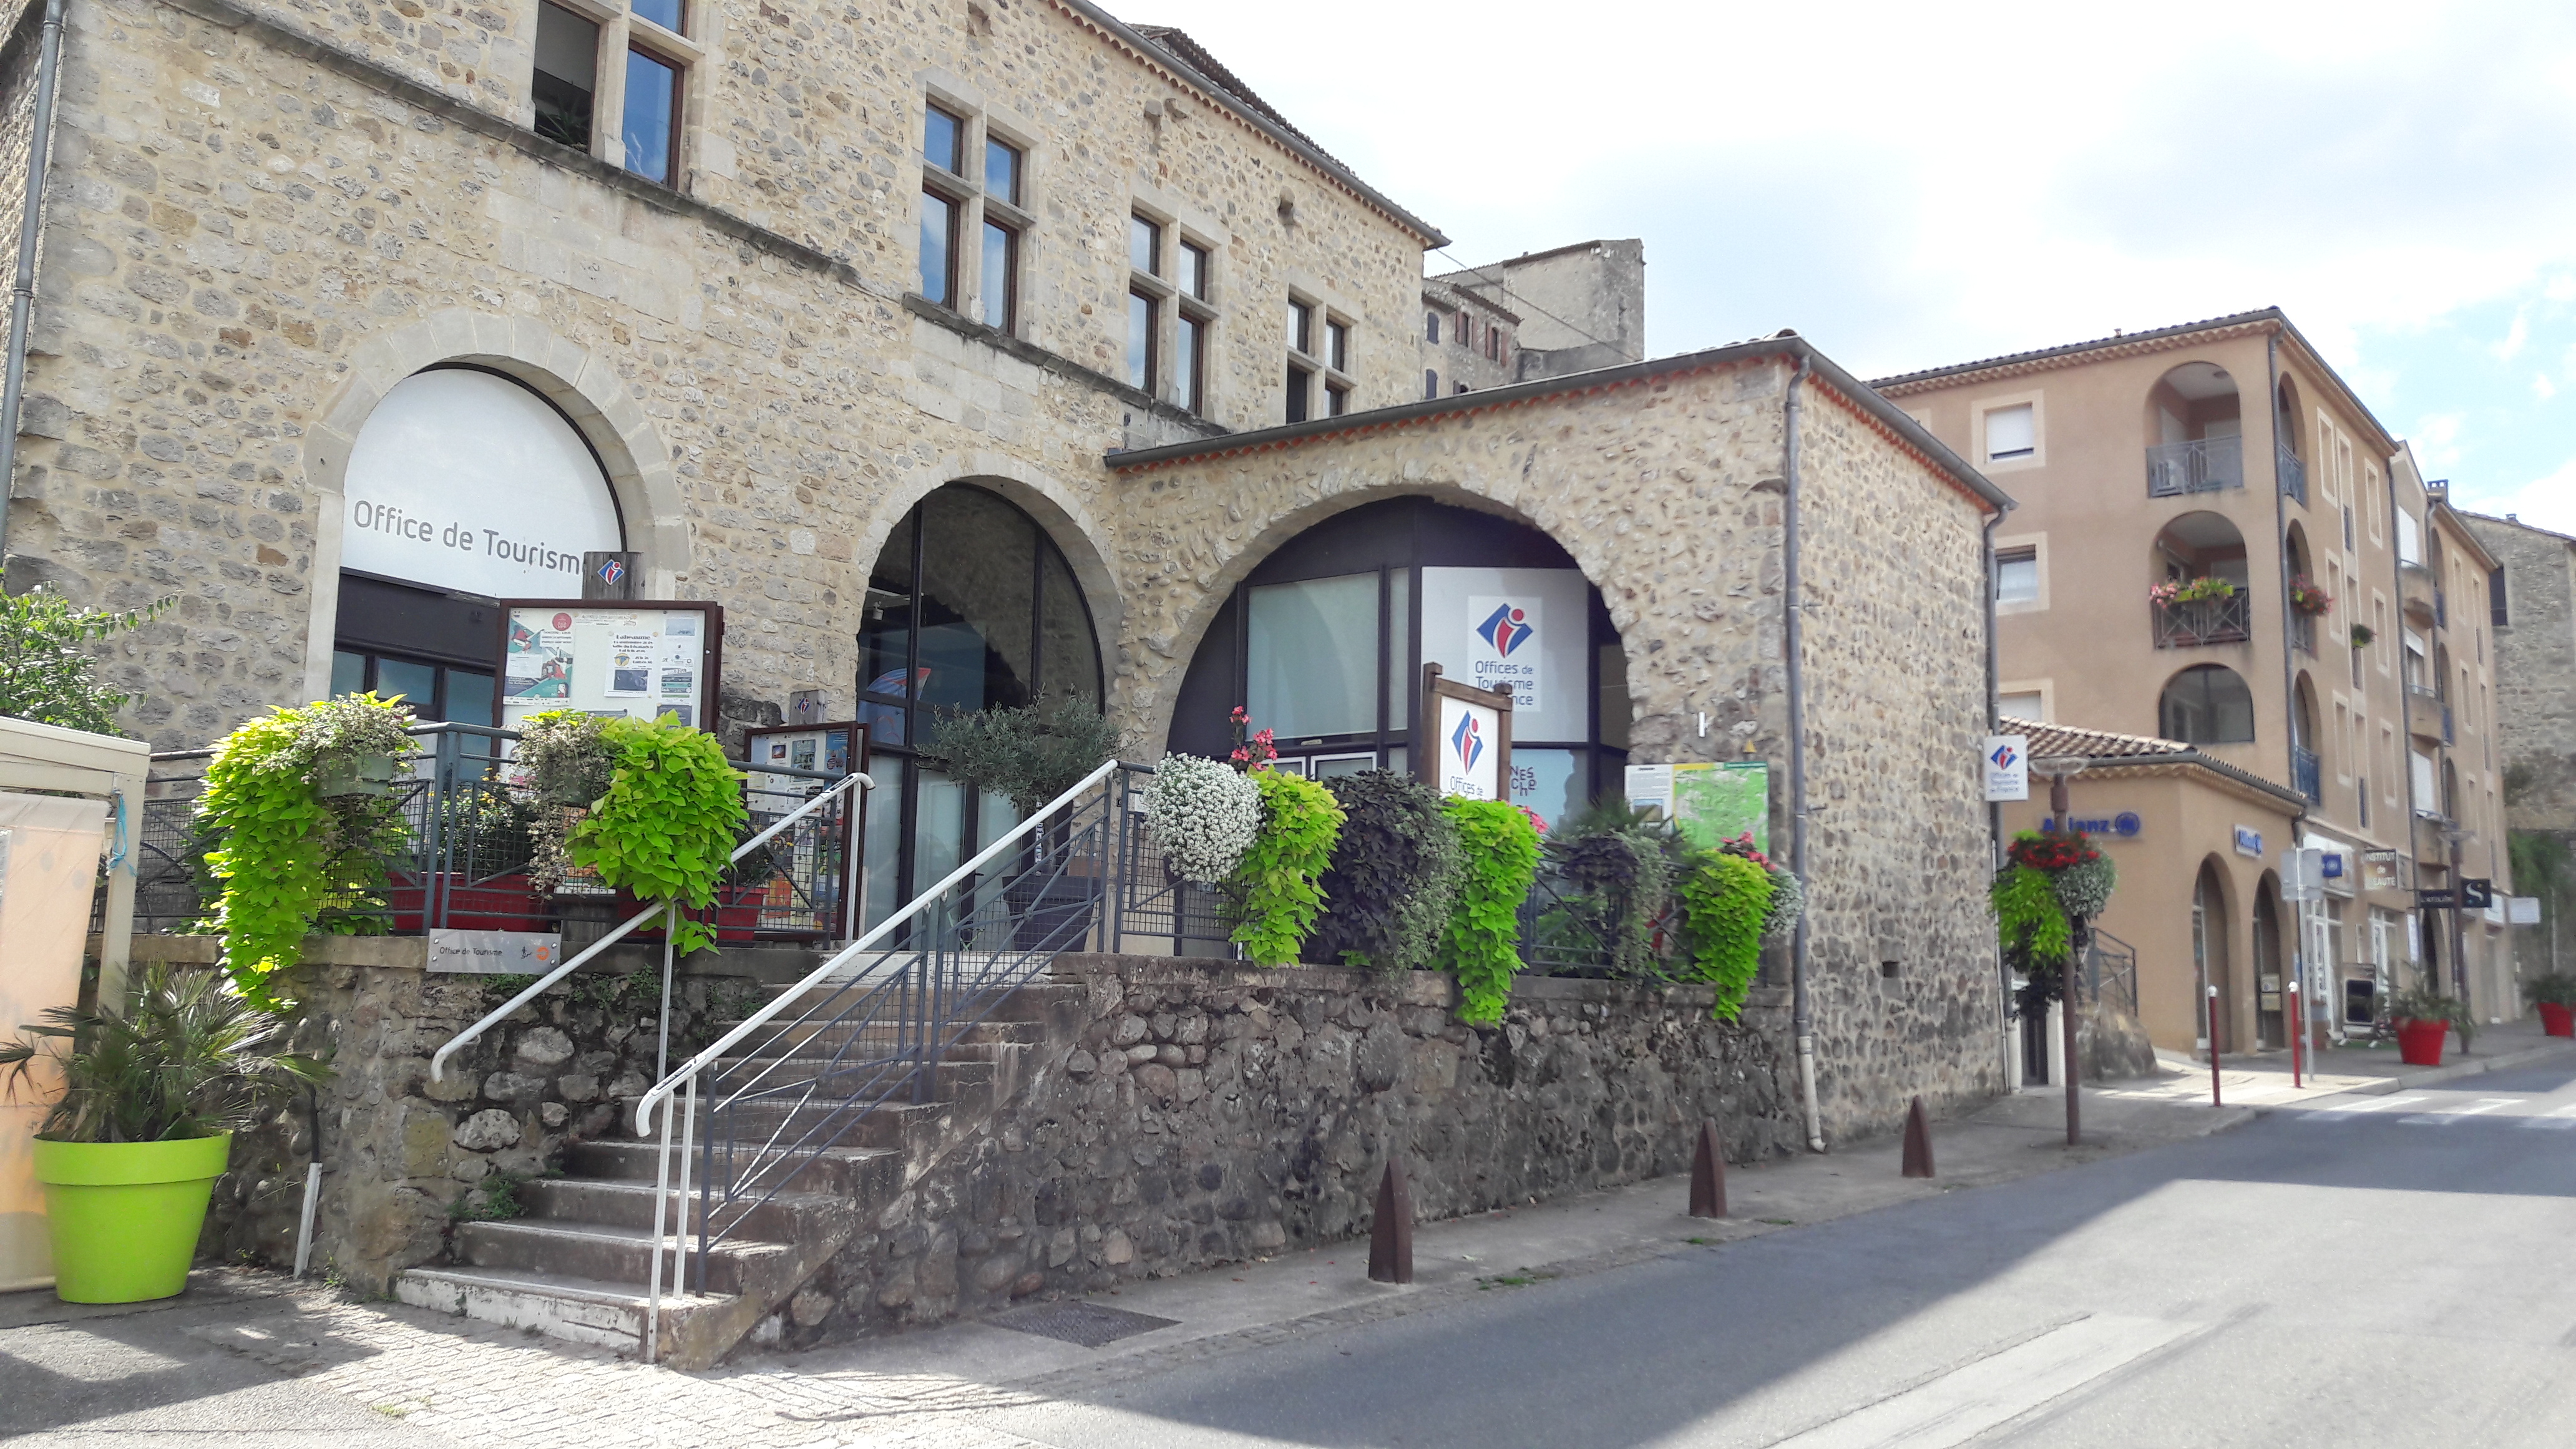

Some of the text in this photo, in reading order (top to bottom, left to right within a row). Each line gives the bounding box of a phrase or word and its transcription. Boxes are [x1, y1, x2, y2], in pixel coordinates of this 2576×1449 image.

[354, 500, 580, 575] Office de Tourism
[1475, 661, 1533, 675] Offices de
[1450, 776, 1484, 796] Offices de
[439, 947, 461, 955] Office
[473, 948, 502, 956] Tourisme
